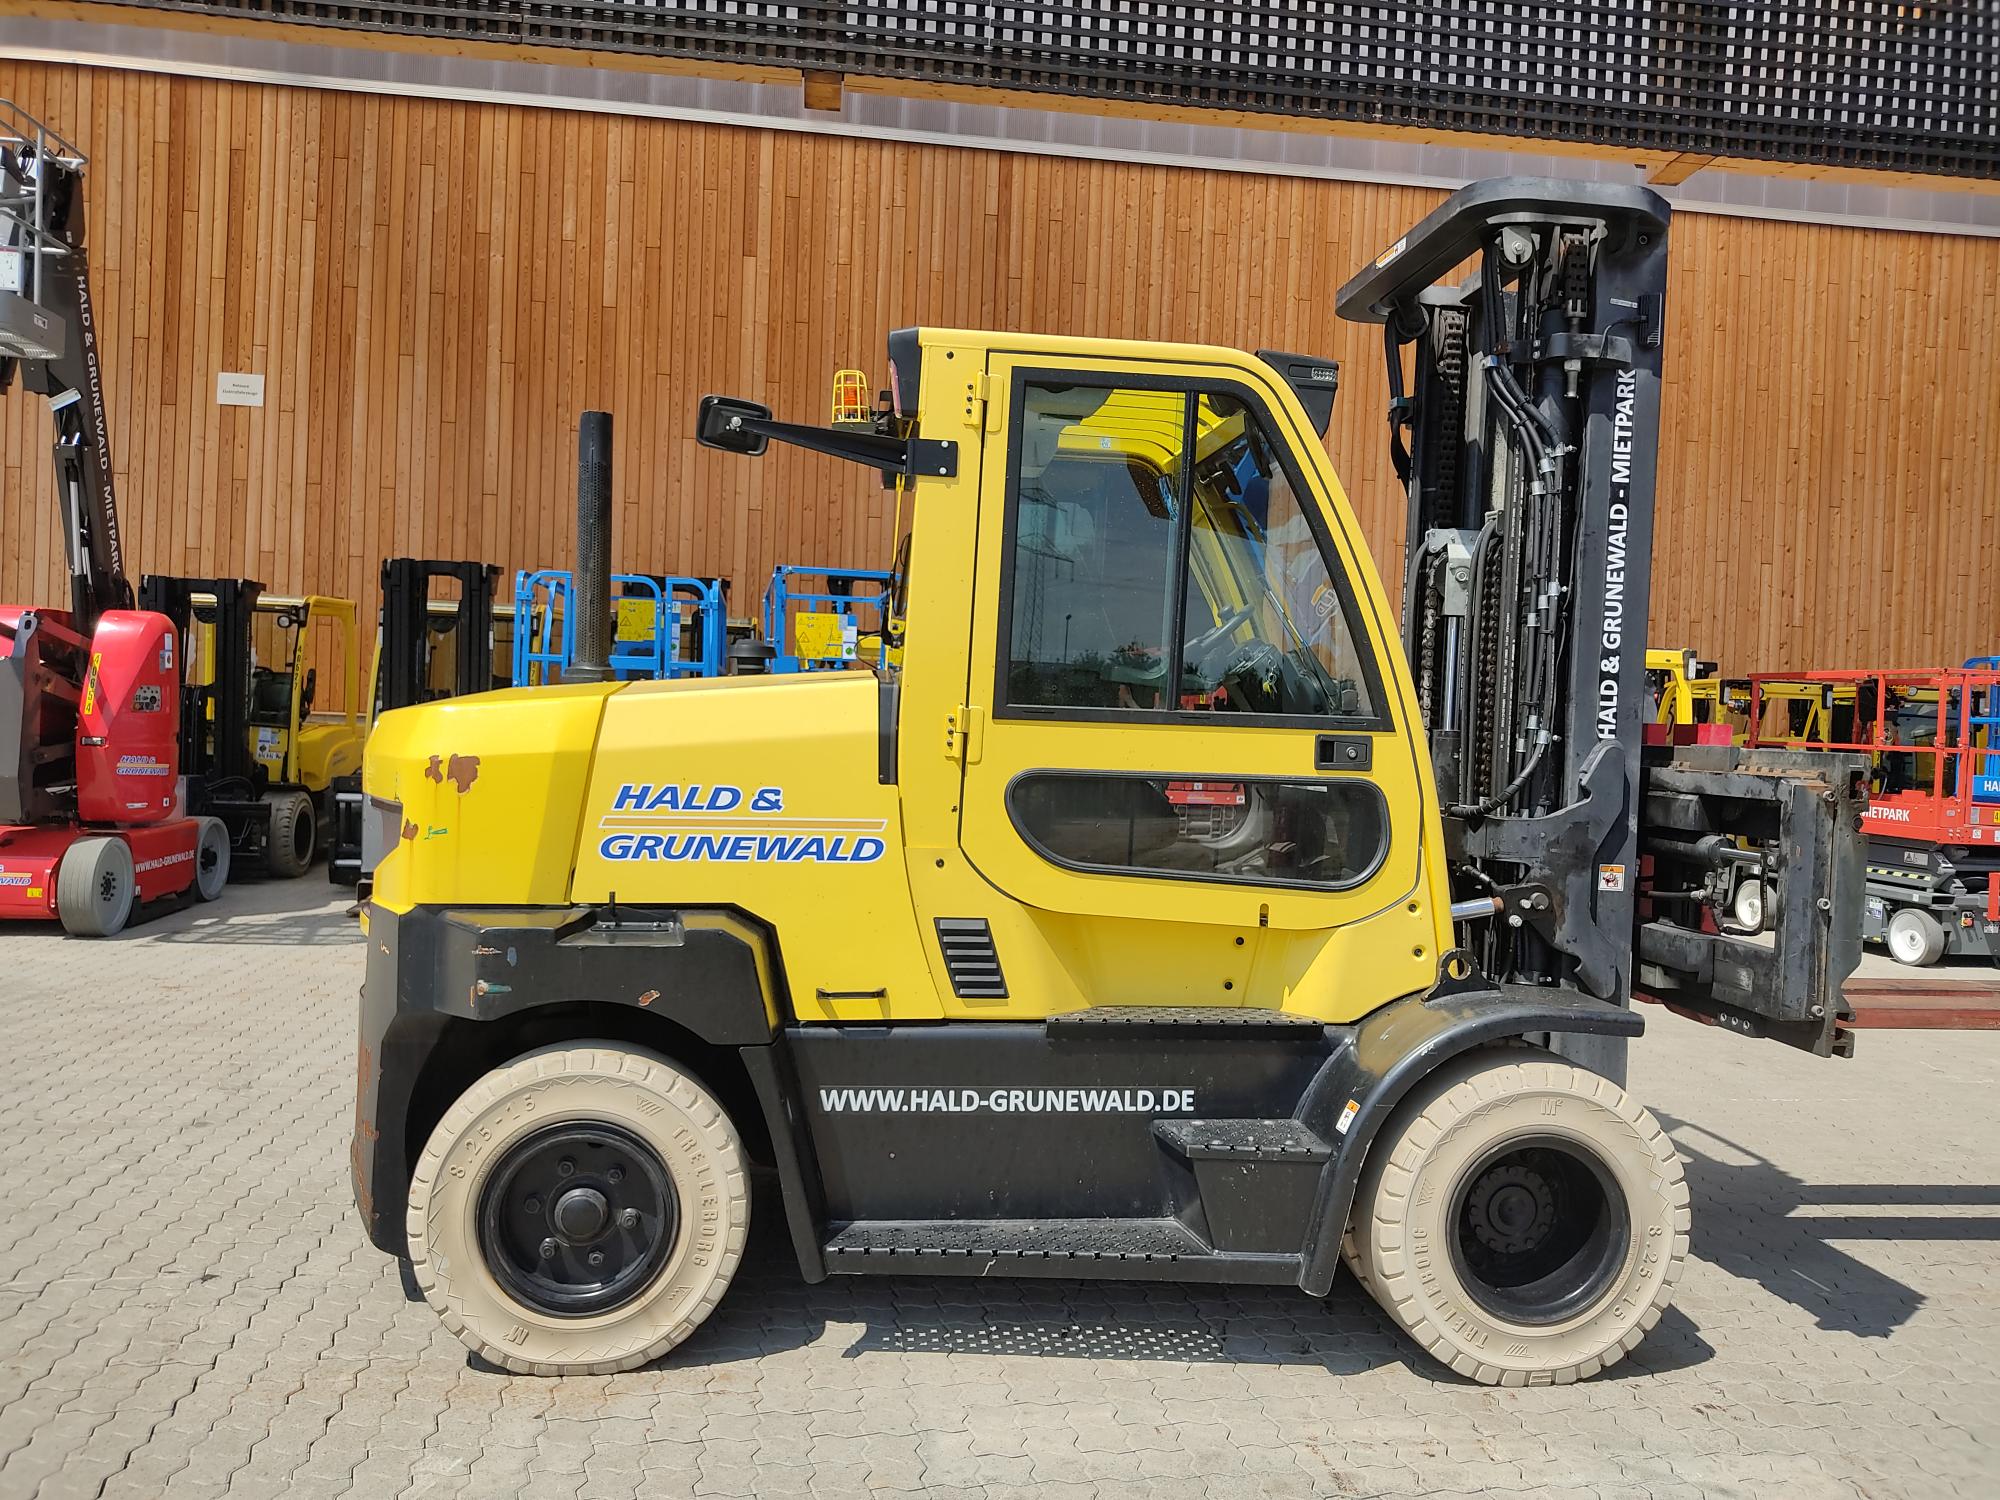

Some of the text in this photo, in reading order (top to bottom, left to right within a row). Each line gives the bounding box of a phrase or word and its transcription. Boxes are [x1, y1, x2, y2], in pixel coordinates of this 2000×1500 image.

[77, 275, 91, 327] HALD
[84, 332, 94, 347] &
[87, 352, 108, 470] GRUNEWALD
[103, 485, 121, 575] MIETPARK
[1597, 368, 1637, 740] HALD & GRUNEWALD - MIETPARK
[612, 784, 784, 812] HALD &
[600, 833, 885, 863] GRUNEWALD
[819, 1087, 1195, 1113] WWW.HALD-GRUNEWALD.DE
[671, 1123, 719, 1268] TRELLEBORG
[1411, 1226, 1489, 1350] TRELLEBORG
